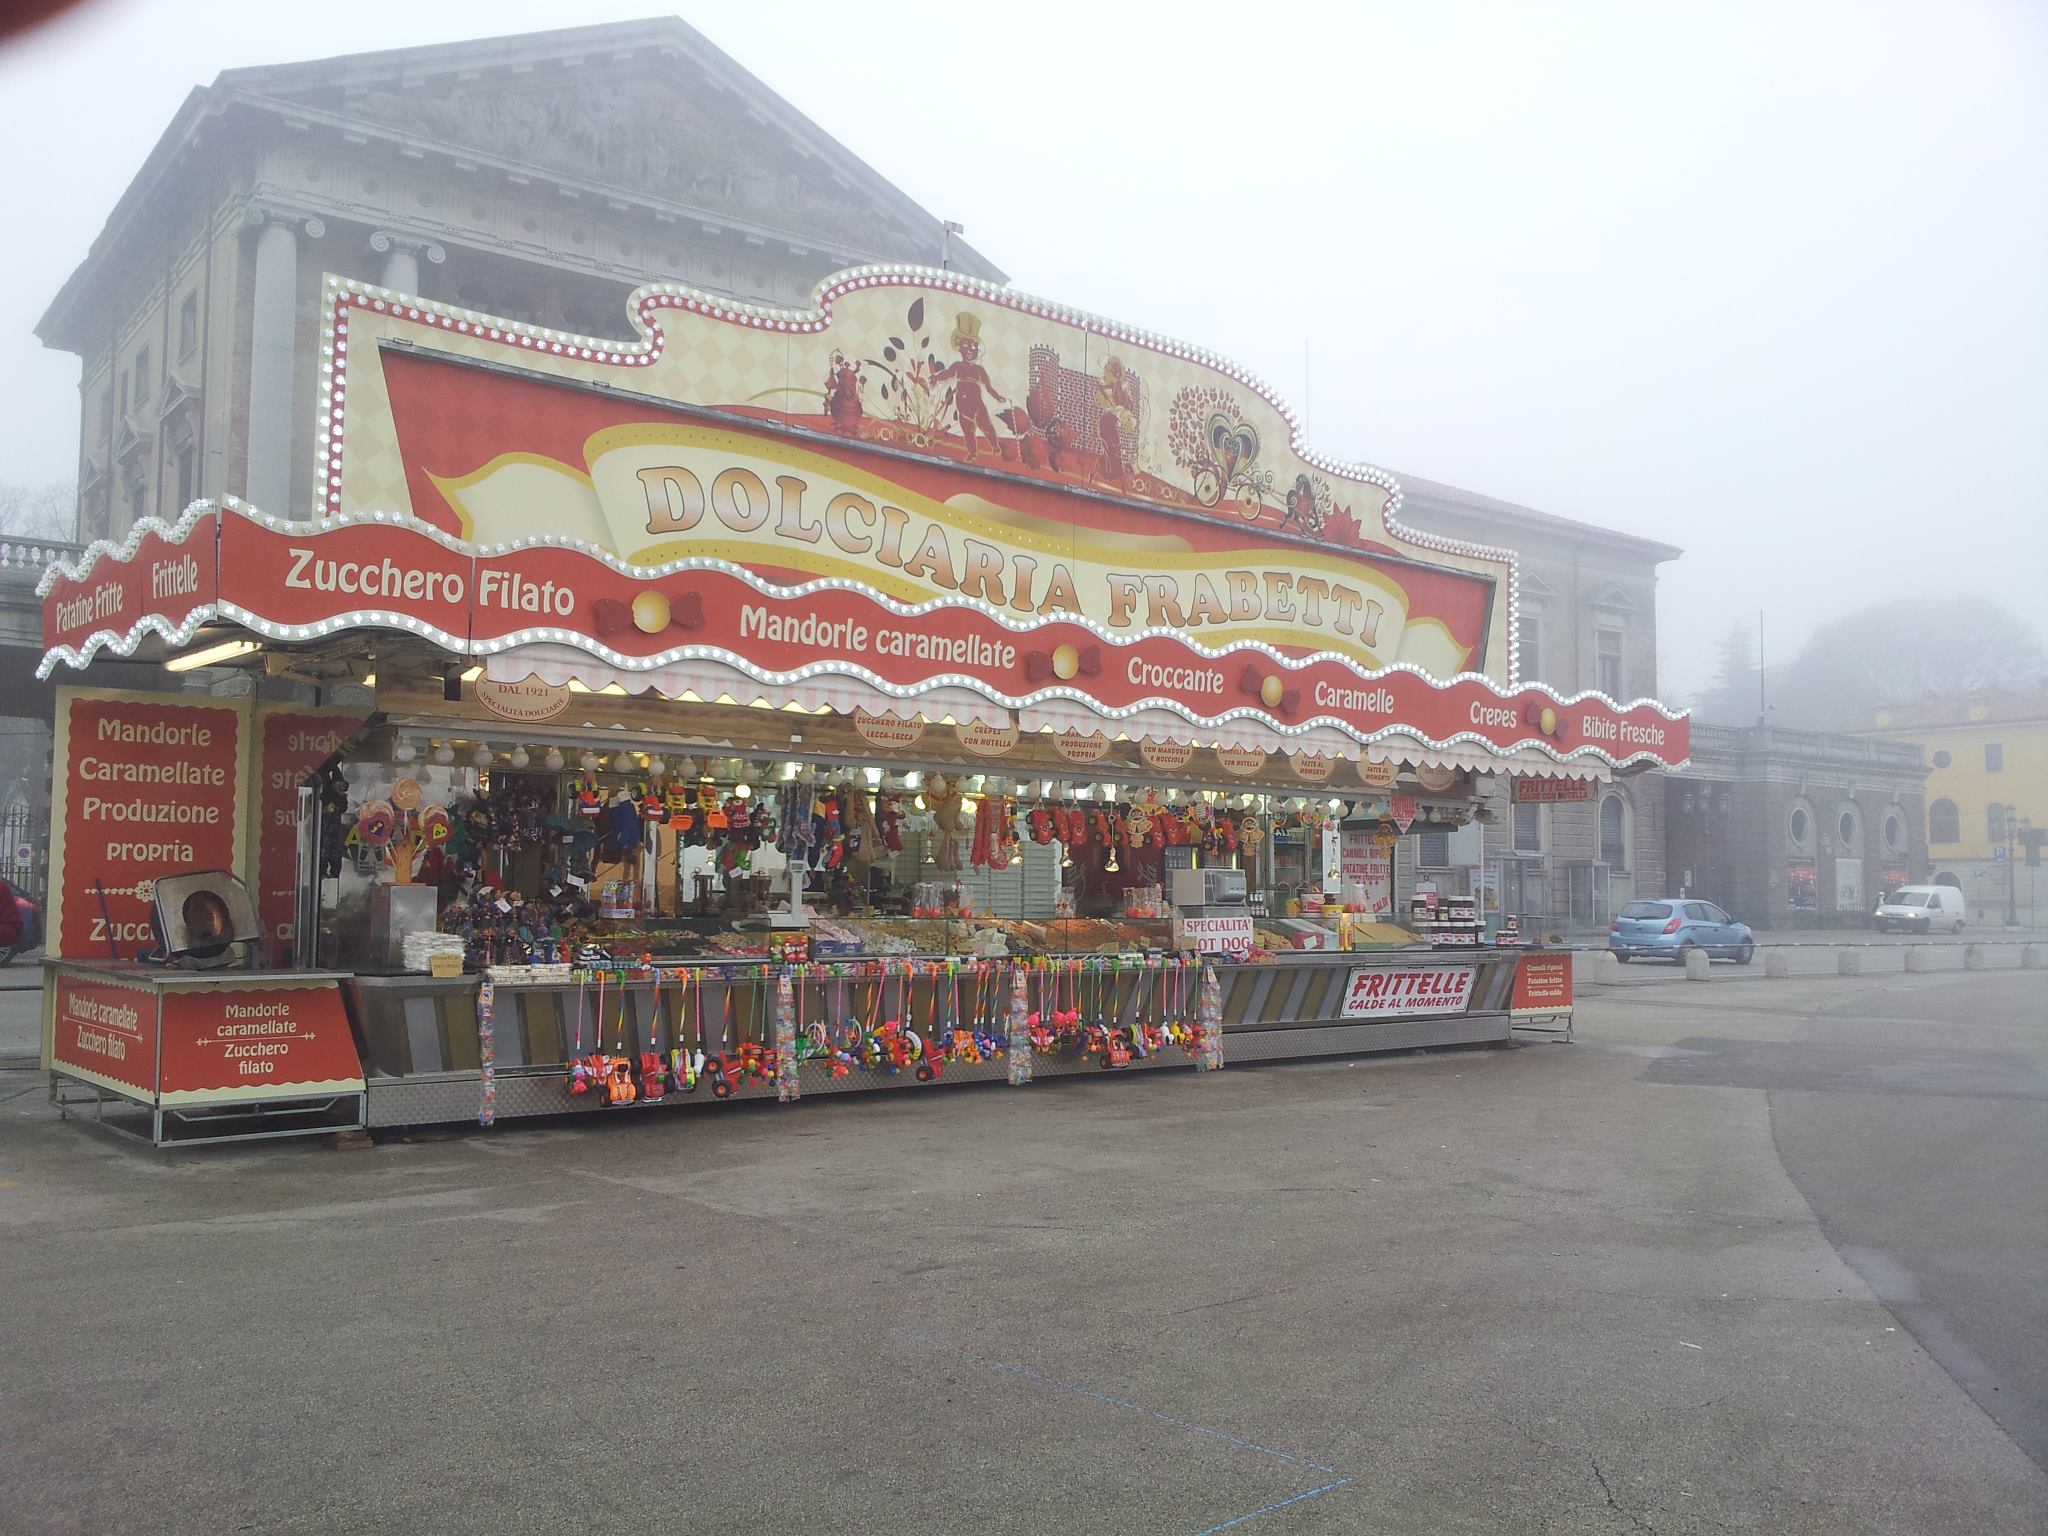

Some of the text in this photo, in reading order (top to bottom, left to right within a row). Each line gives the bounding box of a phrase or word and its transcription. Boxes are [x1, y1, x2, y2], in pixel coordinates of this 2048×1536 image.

[637, 466, 1384, 647] DOLCIARIA FRABETTI
[153, 553, 198, 599] Frittelle
[285, 548, 575, 616] Zucchero Filato
[56, 581, 123, 634] Patatine Fritte
[740, 604, 1016, 669] Mandorle caramellate
[1127, 656, 1224, 695] Croccante
[498, 684, 549, 697] DAL 1921
[1314, 681, 1395, 714] Caramelle
[856, 717, 922, 730] ZUCCHERO FILATO
[1470, 701, 1517, 729] Crepes
[97, 718, 212, 747] Mandorle
[866, 730, 914, 741] LECCA-LECCA
[1582, 714, 1665, 746] Bibite Fresche
[963, 737, 1012, 748] CON NUTELLA
[1061, 740, 1103, 749] PRODUZIONE
[1157, 747, 1190, 755] MANDORLE
[1067, 750, 1096, 758] PROPRIA
[1156, 756, 1184, 764] NOCCIOLE
[79, 757, 225, 786] Caramellate
[1300, 768, 1326, 776] MOMENTO
[1519, 778, 1587, 793] FRITTELLE
[83, 797, 219, 824] Produzione
[1349, 834, 1376, 845] FRITTEL
[106, 839, 194, 862] propria
[1343, 863, 1390, 874] PATATINE FRITTE
[89, 918, 156, 941] Zucc
[1186, 919, 1250, 932] SPECIALITA'
[1197, 937, 1250, 951] OT DOG
[1352, 972, 1470, 998] FRITTELLE
[225, 1002, 290, 1019] Mandorle
[1348, 996, 1463, 1010] CALDE AL MOMENTO
[69, 992, 138, 1032] Mandorle caramellate
[216, 1020, 297, 1037] caramellate
[77, 1025, 126, 1060] Zucchero filato
[223, 1041, 289, 1058] Zucchero
[238, 1060, 274, 1075] filato
